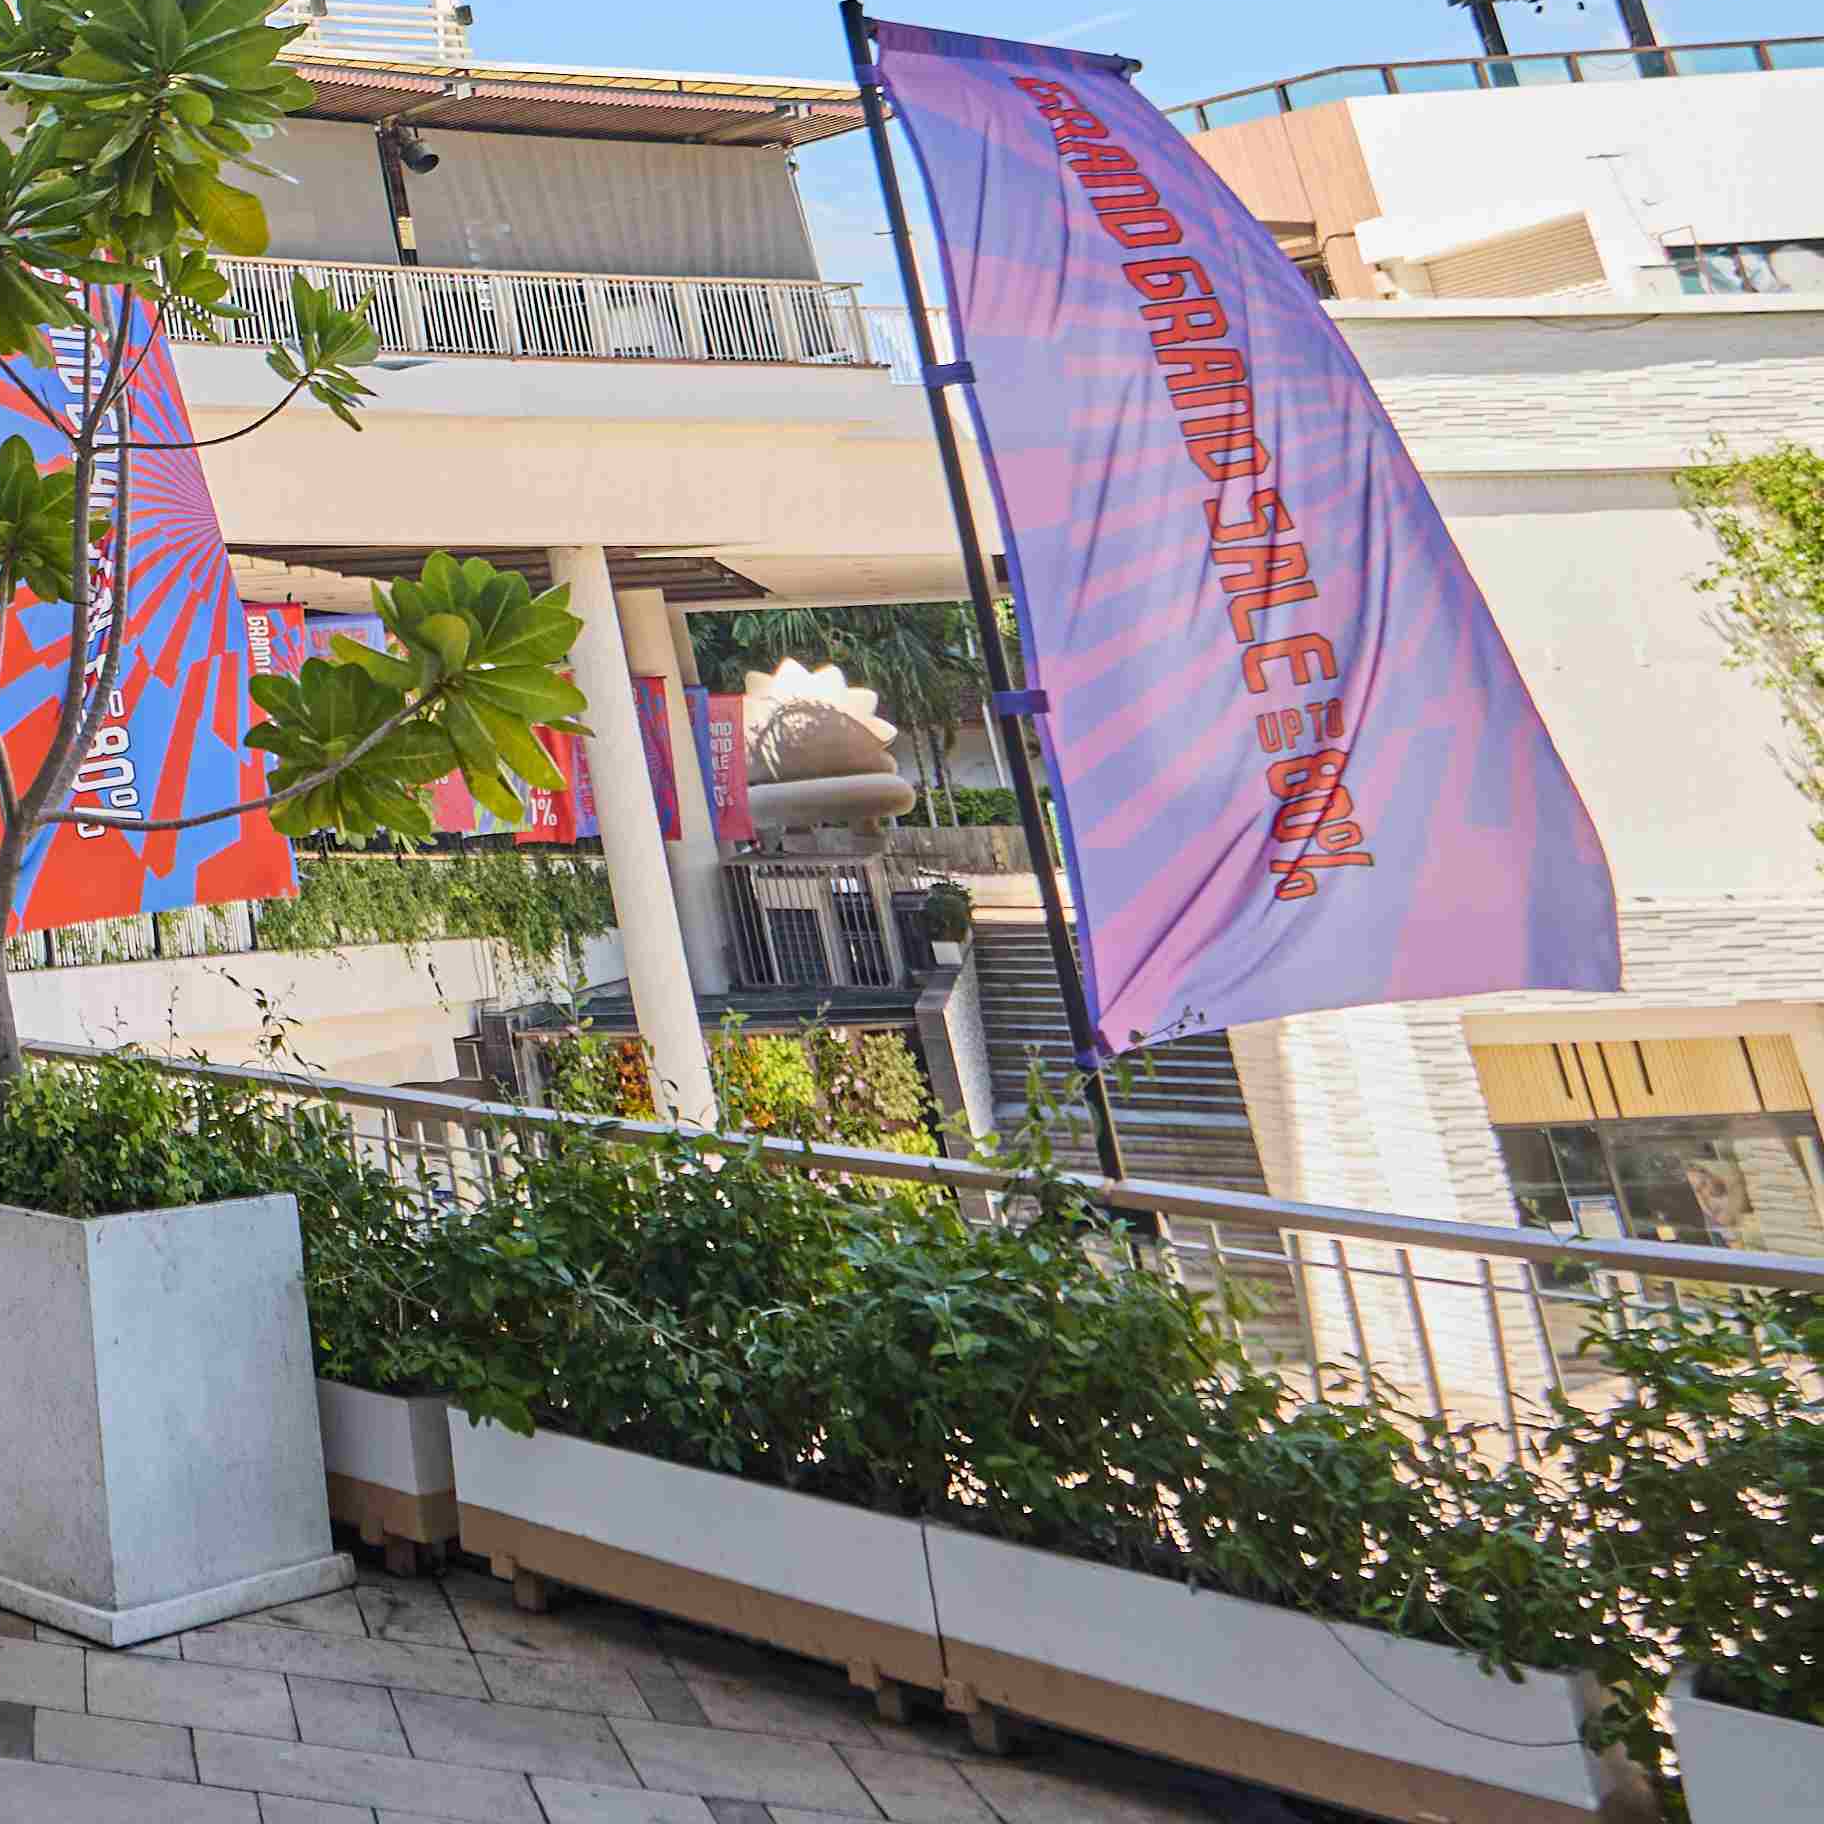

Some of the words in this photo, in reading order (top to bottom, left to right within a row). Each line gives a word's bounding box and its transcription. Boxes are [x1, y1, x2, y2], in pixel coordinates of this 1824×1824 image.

[1009, 76, 1184, 250] GRAND
[1121, 255, 1272, 482] GRAND
[1203, 487, 1338, 695] SALE
[1256, 710, 1304, 754] UP
[1305, 698, 1345, 742] TO
[1266, 747, 1375, 902] 80%
